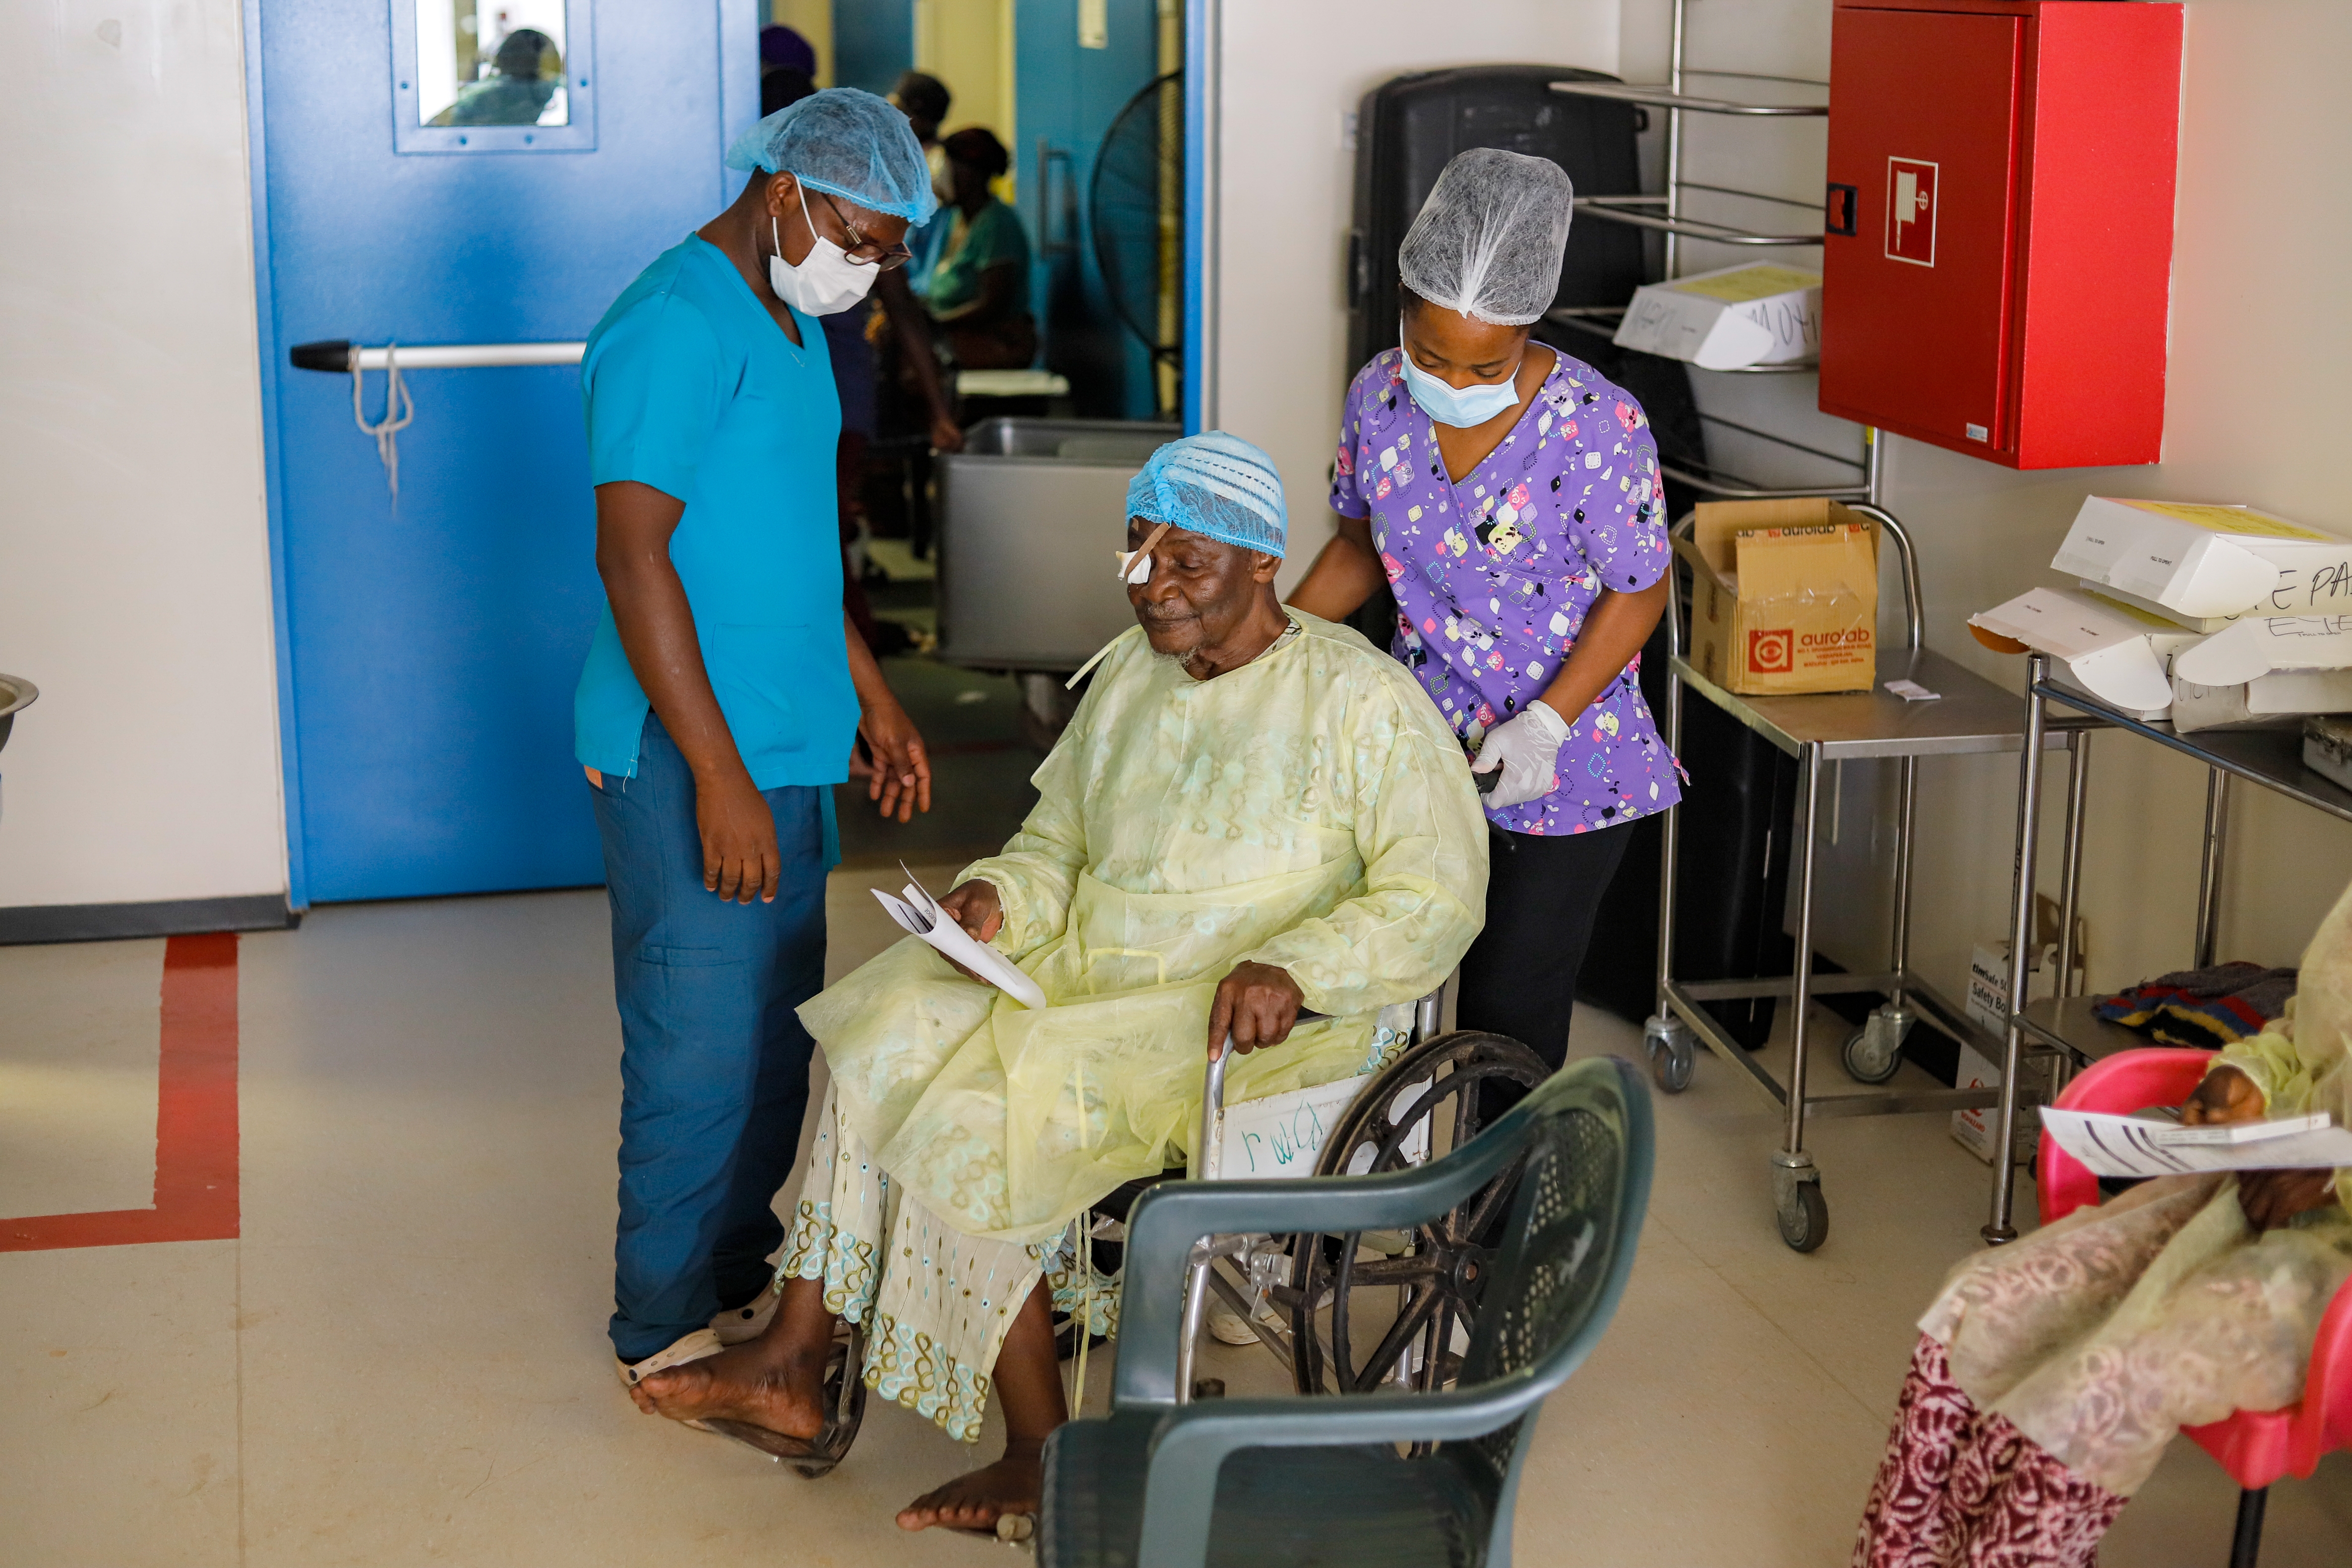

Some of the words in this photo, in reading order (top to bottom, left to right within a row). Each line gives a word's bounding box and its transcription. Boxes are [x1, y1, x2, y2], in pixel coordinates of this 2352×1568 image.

[2310, 561, 2352, 606] PA
[1801, 627, 1870, 646] aurolab
[1973, 981, 1993, 1008] Safety
[1995, 996, 2006, 1013] Bo
